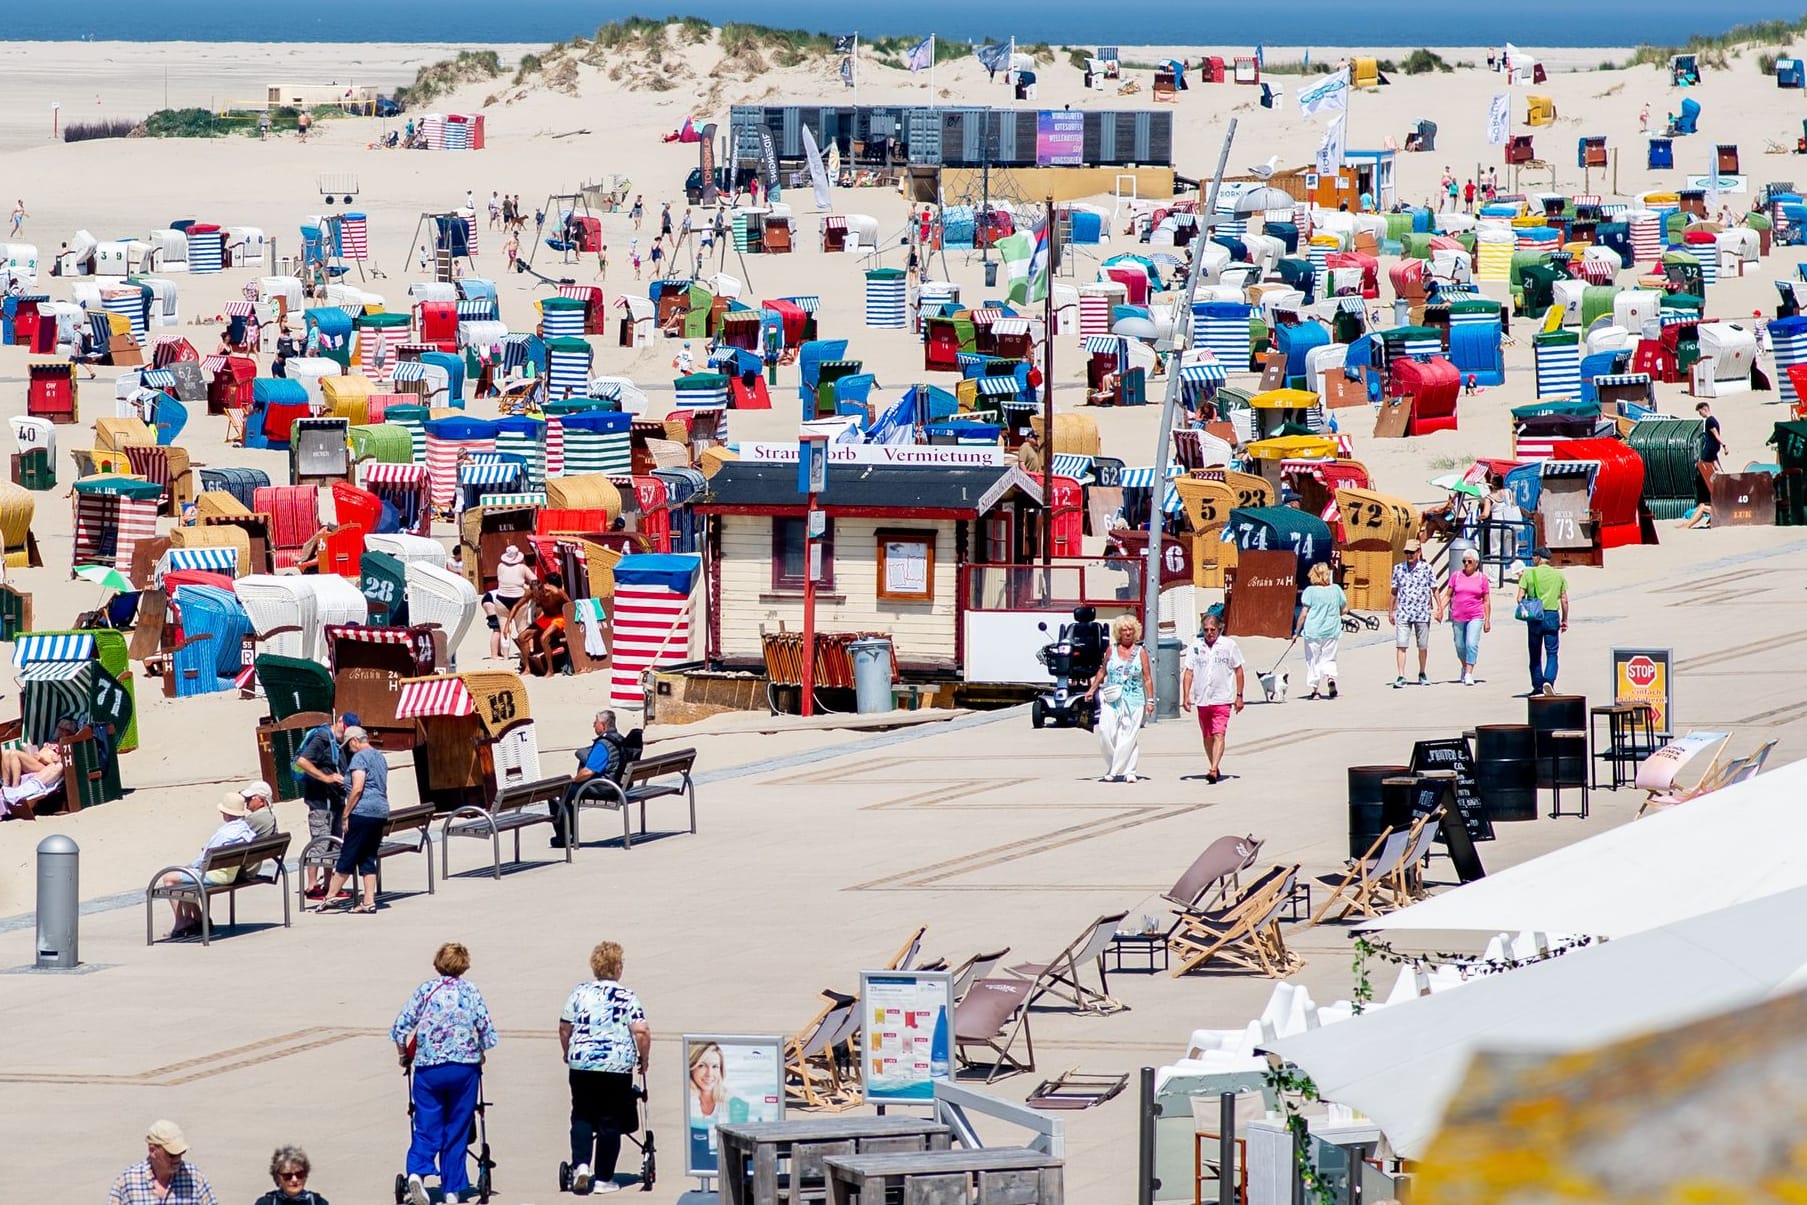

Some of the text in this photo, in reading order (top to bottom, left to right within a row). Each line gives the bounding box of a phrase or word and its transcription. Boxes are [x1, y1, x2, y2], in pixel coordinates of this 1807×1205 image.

[19, 425, 36, 442] 40
[755, 445, 993, 465] Stranorb Vermietung
[1102, 467, 1118, 485] 62
[641, 485, 655, 503] 57
[1239, 489, 1266, 508] 23
[1201, 498, 1216, 520] 5
[1348, 502, 1383, 528] 72
[1239, 522, 1268, 551] 74
[1556, 518, 1575, 540] 73
[1290, 532, 1315, 560] 74
[363, 577, 394, 602] 28
[1276, 578, 1284, 586] 74
[1285, 576, 1294, 586] H
[388, 671, 398, 679] 24
[1629, 665, 1654, 678] STOP
[389, 680, 398, 692] H
[97, 678, 123, 717] 71
[293, 691, 301, 710] 1
[517, 731, 527, 742] T.
[64, 755, 72, 767] H
